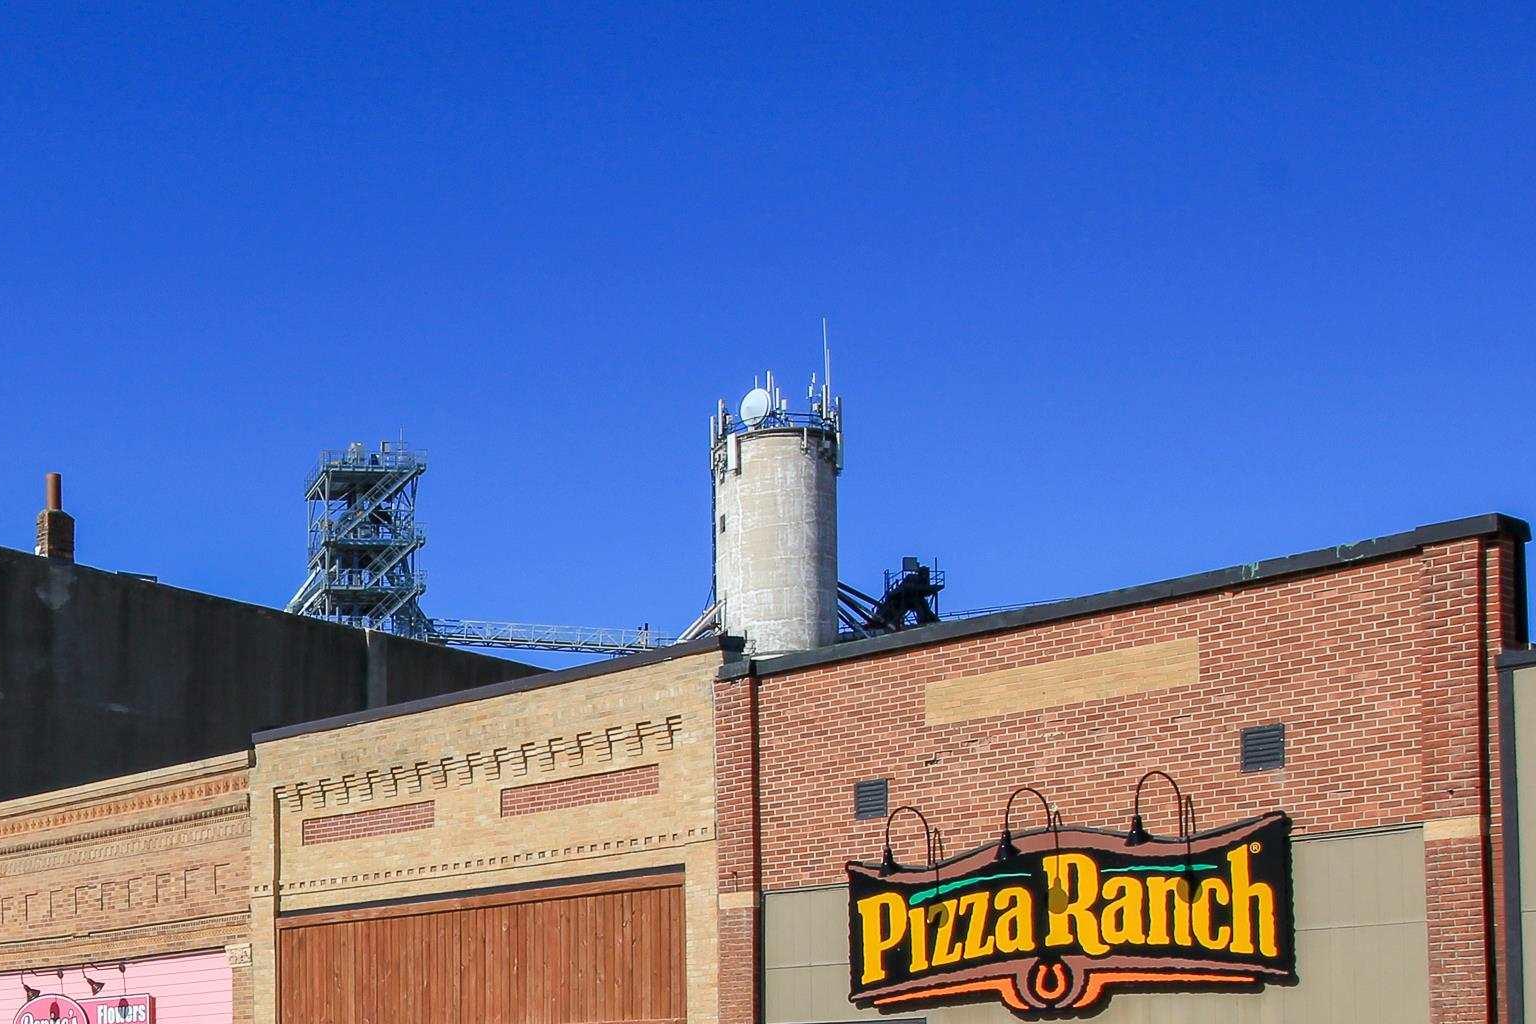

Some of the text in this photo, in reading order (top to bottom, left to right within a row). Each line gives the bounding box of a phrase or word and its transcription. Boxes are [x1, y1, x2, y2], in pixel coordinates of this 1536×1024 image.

[857, 844, 1278, 985] Pizza Ranch
[96, 1003, 147, 1024] Flowers
